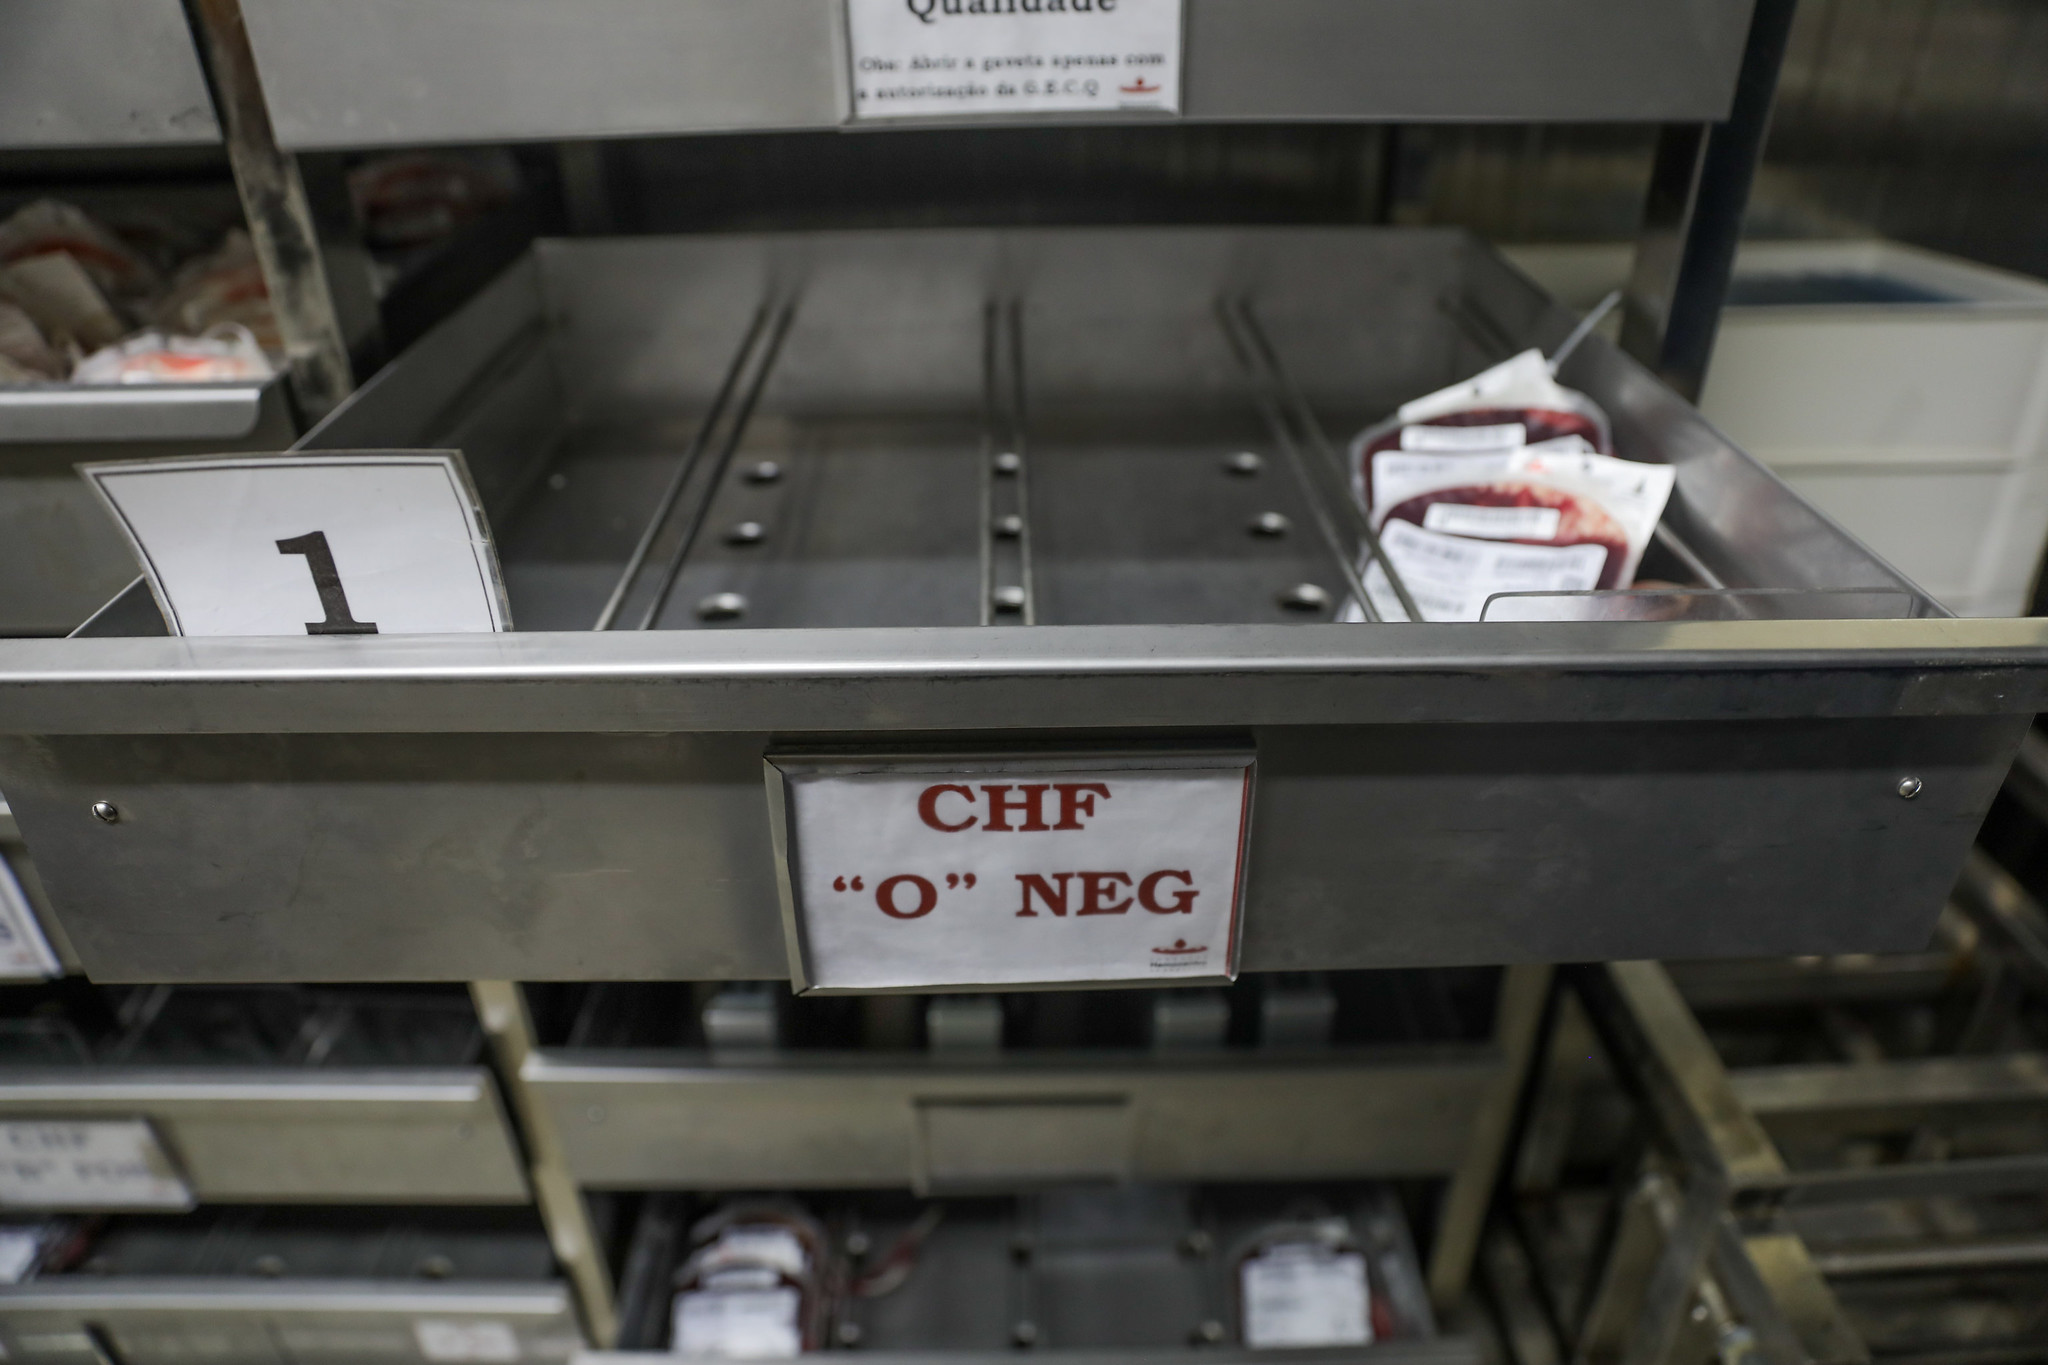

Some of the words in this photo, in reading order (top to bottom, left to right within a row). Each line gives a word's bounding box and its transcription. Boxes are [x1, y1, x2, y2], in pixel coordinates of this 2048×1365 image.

[275, 530, 379, 635] 1
[917, 782, 1112, 833] CHF
[1015, 869, 1201, 918] NEG
